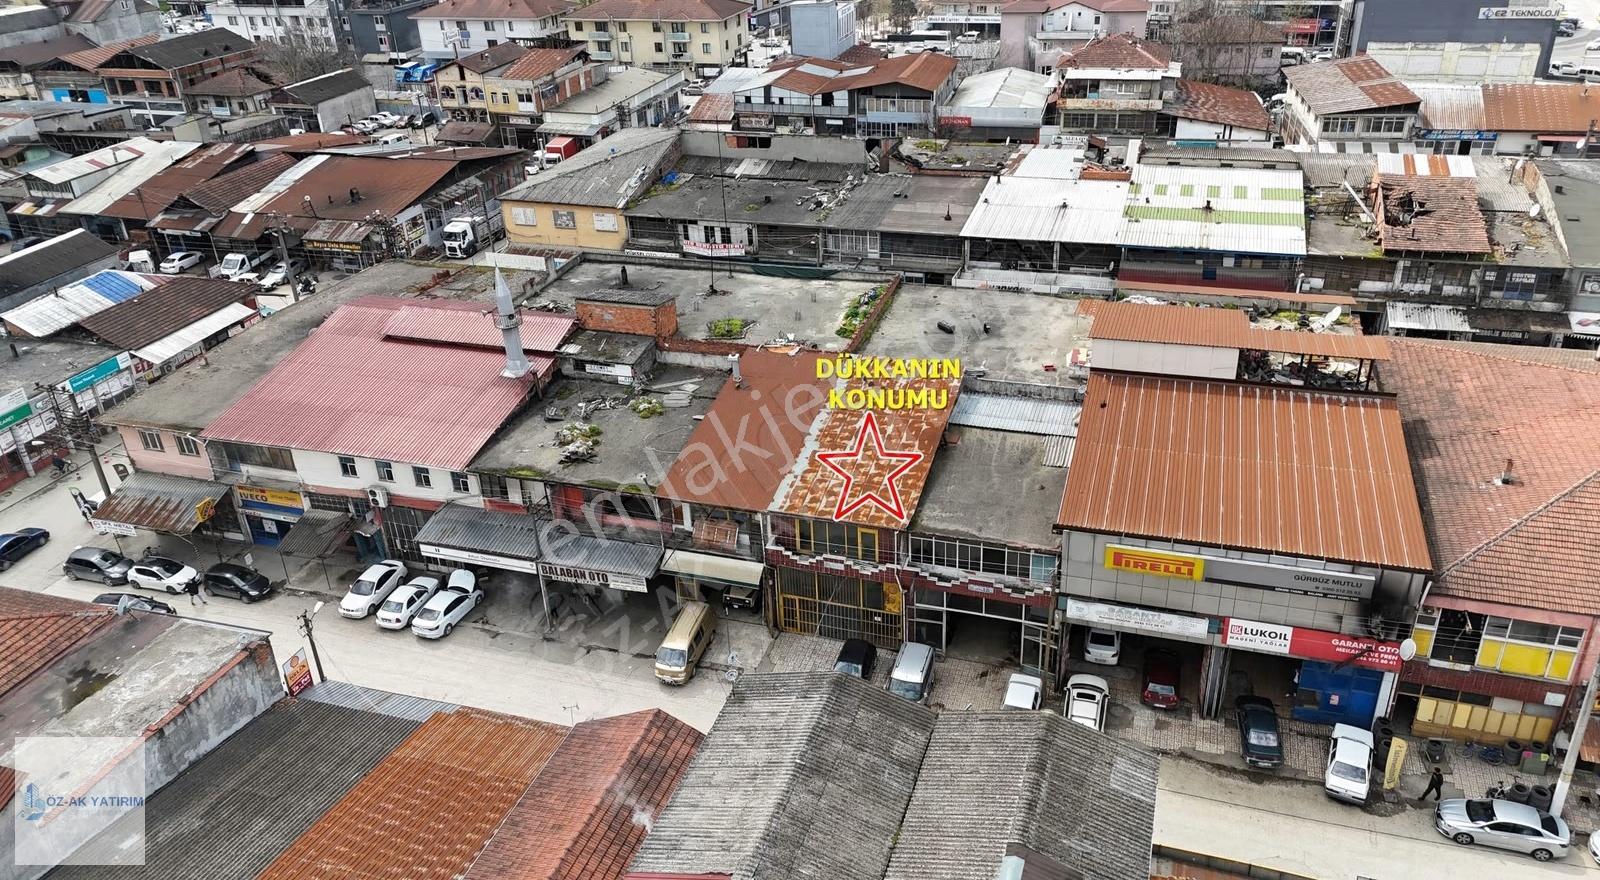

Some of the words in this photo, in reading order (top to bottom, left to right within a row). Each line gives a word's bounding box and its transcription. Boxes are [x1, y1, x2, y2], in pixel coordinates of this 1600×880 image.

[239, 492, 268, 502] IVECO
[1112, 551, 1195, 577] PIRELLI
[540, 564, 587, 580] BALABAN
[589, 571, 609, 583] OTO
[1293, 574, 1331, 585] GÜRBÜZ
[1332, 579, 1363, 589] MUTLU
[1244, 627, 1288, 641] LUKOIL
[1335, 647, 1369, 656] MEKANK
[1378, 645, 1399, 654] OTO
